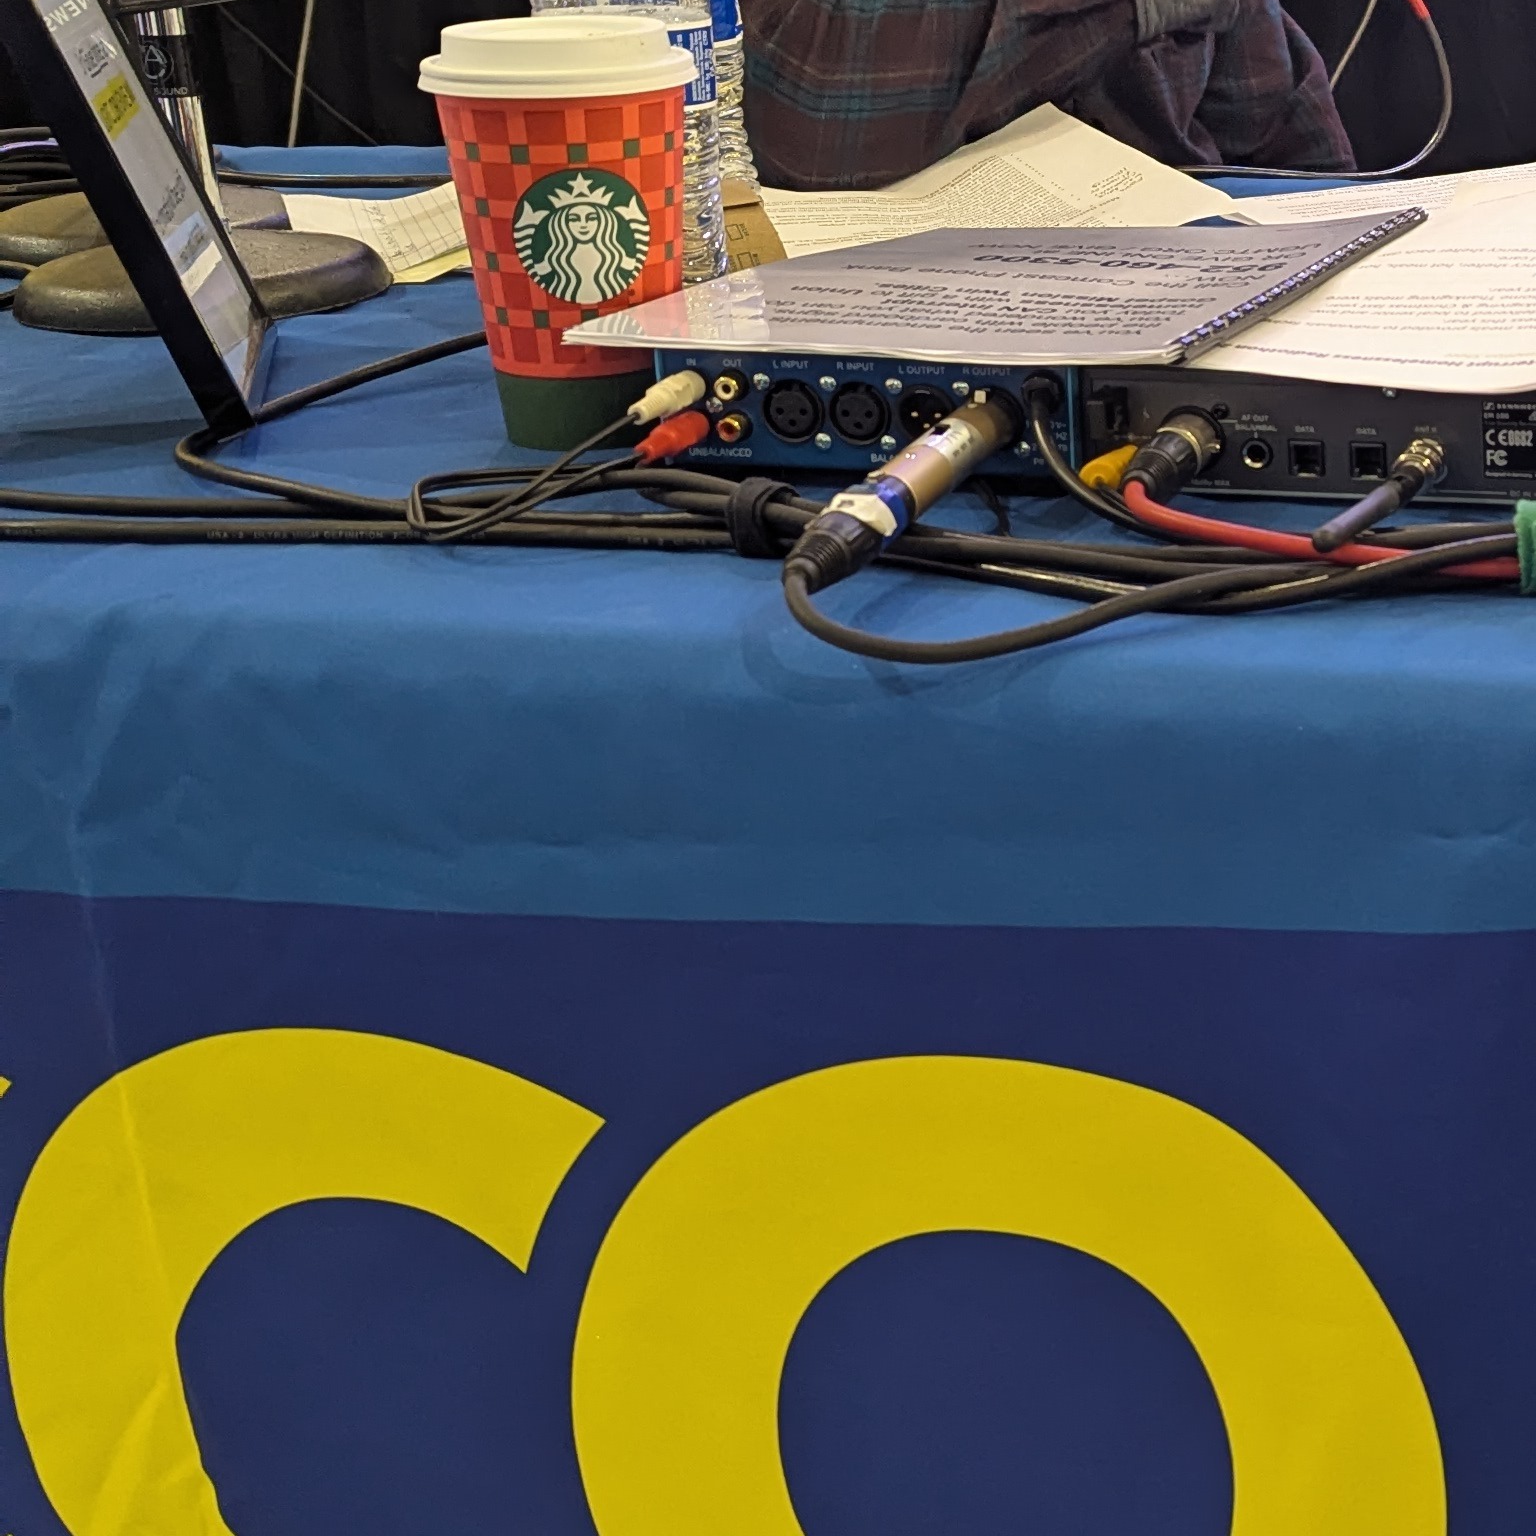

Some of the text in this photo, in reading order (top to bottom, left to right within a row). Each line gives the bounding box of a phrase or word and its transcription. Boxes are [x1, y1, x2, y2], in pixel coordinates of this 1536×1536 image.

[686, 358, 696, 367] IN
[723, 358, 742, 368] OUT
[780, 360, 809, 370] INPUT
[846, 362, 874, 372] INPUT
[907, 366, 946, 376] OUTPUT
[972, 367, 1011, 377] OUTPUT
[689, 447, 753, 458] UNBALANCED
